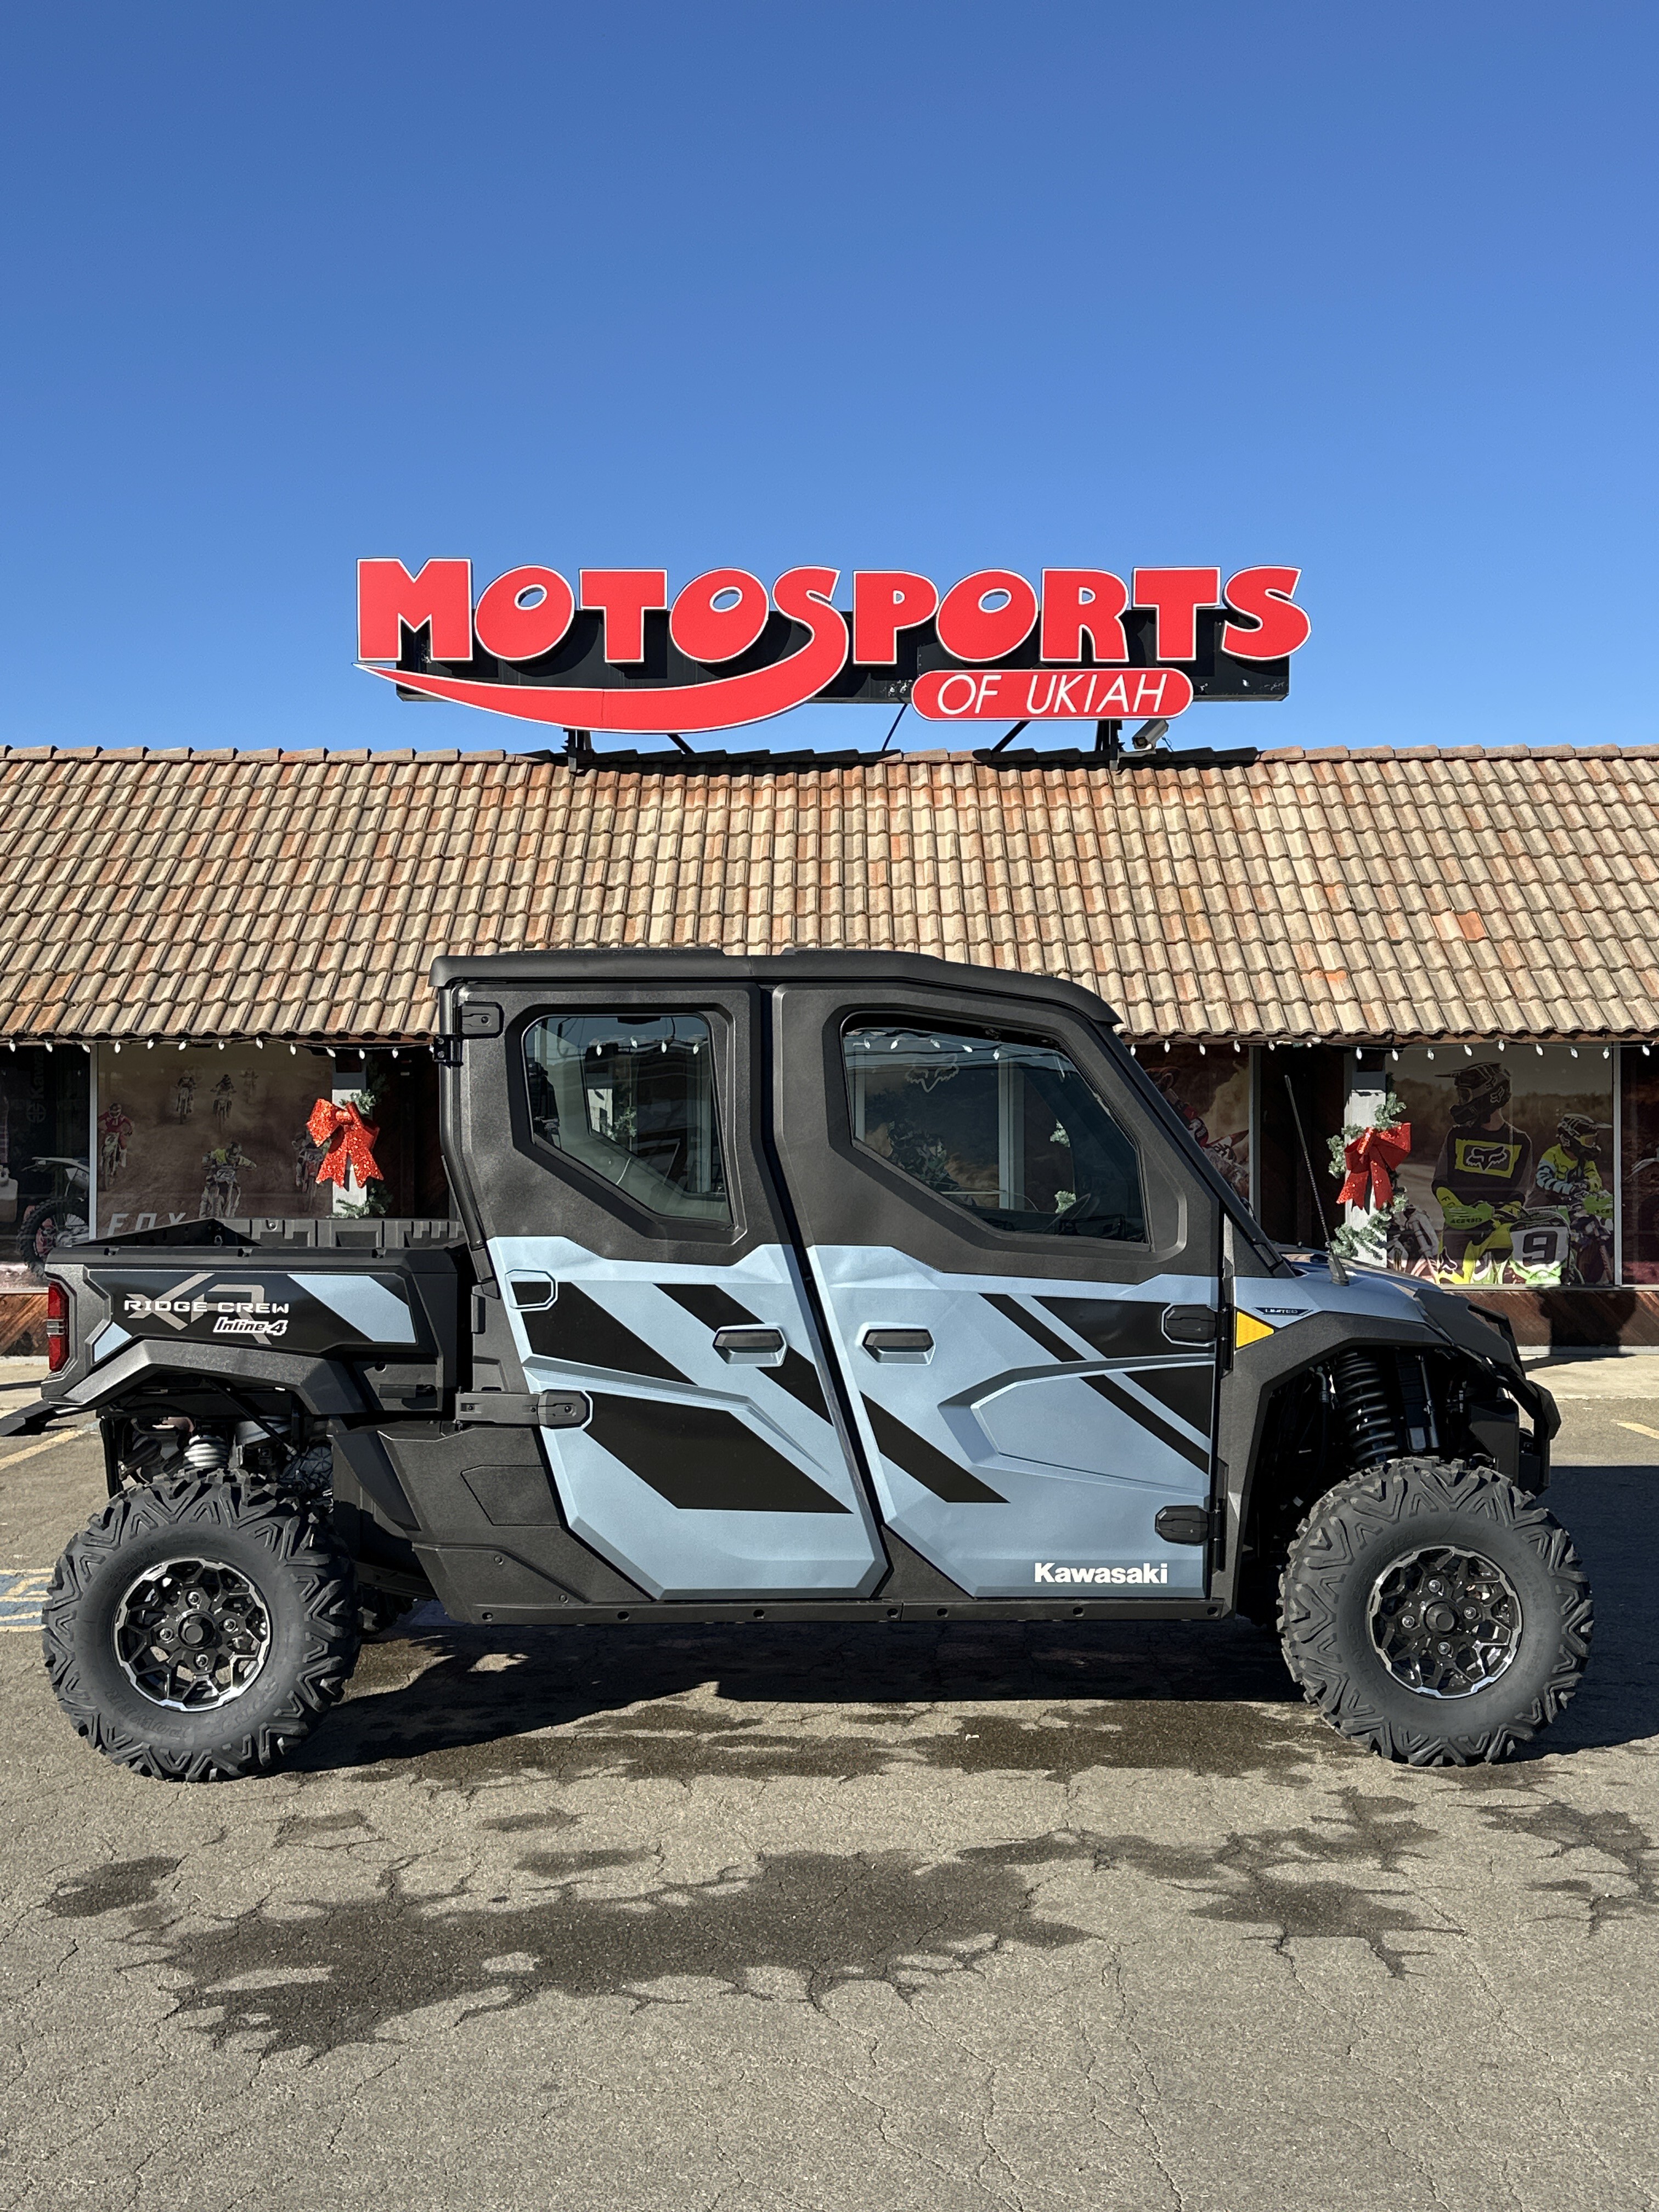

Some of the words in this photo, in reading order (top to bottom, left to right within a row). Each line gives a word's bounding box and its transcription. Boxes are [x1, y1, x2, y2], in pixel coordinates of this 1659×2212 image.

[356, 558, 1312, 732] MOTOSPORTS
[937, 673, 1002, 714] OF
[1026, 673, 1168, 714] UKIAH
[30, 1048, 45, 1101] Kawa
[106, 1211, 187, 1237] FOX
[1522, 1231, 1558, 1267] 9
[124, 1300, 208, 1312] RIDGE
[217, 1302, 289, 1313] CREW
[1035, 1562, 1167, 1583] Kawasaki
